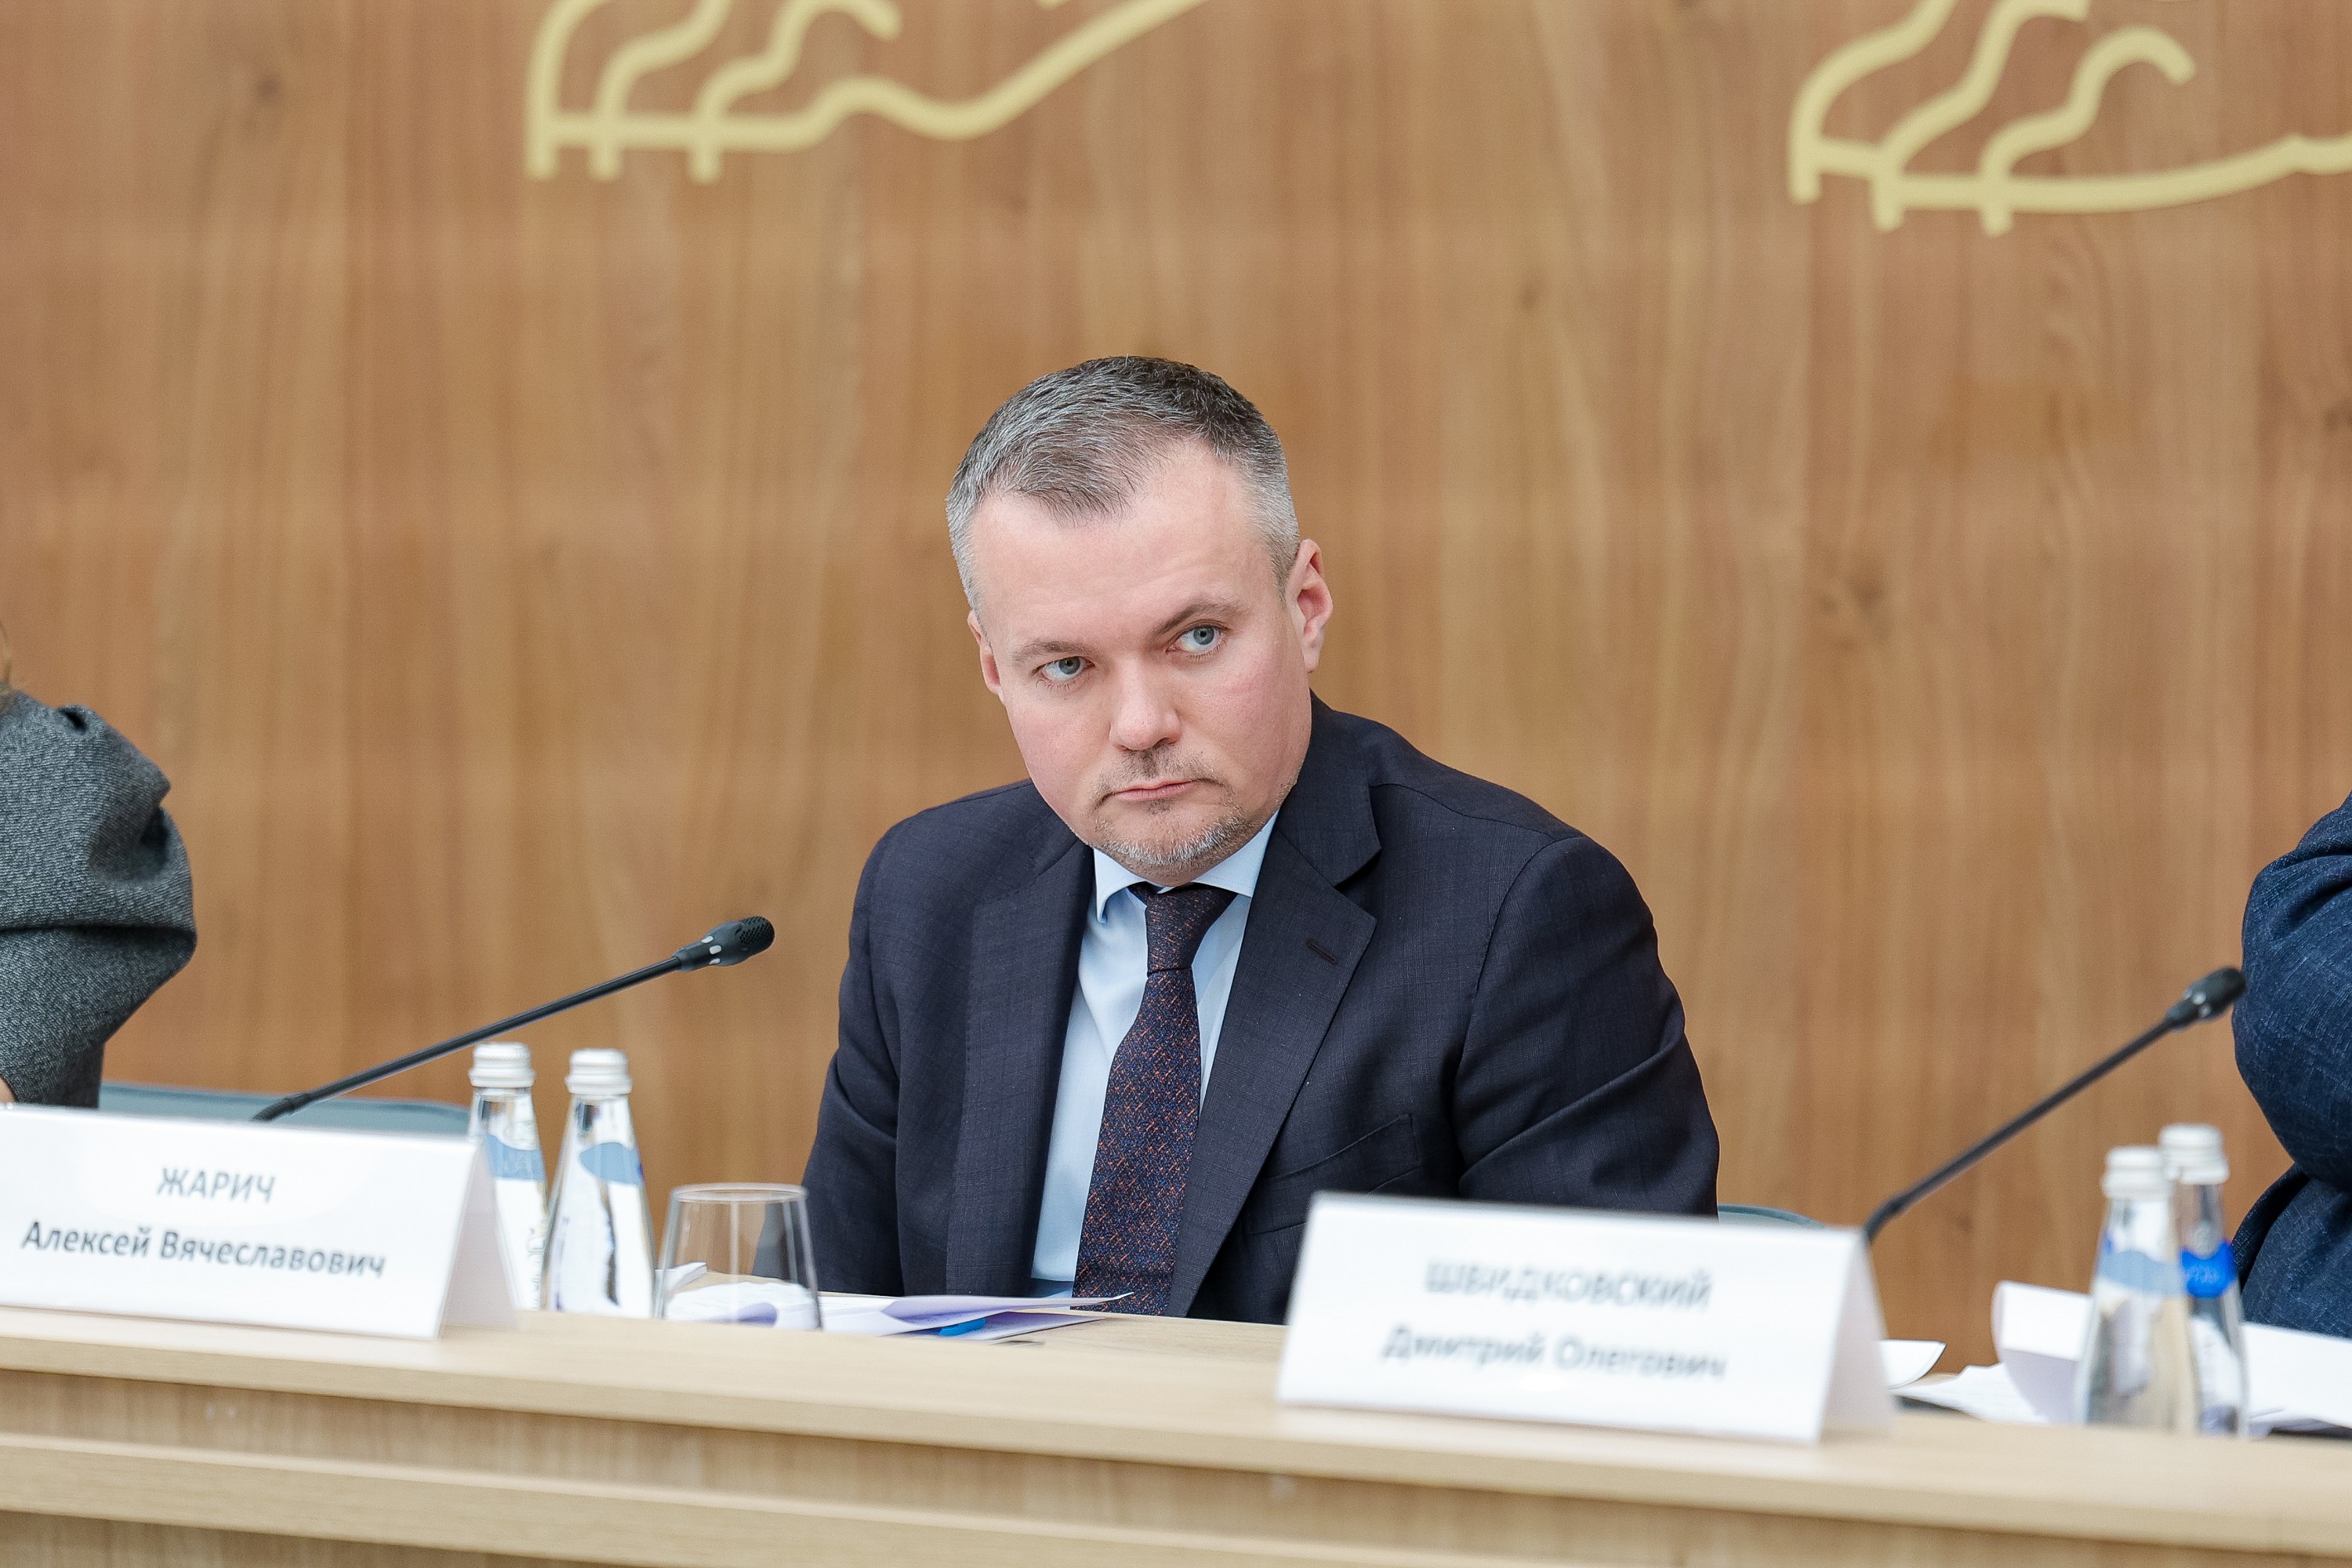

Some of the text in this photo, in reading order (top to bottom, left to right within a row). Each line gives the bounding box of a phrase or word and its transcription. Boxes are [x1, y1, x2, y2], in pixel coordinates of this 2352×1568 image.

[157, 1167, 275, 1202] ЖАРИЧ
[20, 1219, 386, 1277] Алексей Вячеславович
[1425, 1262, 1712, 1308] ШВИДКОВСКИЙ
[1381, 1324, 1727, 1378] Дмитрий Олегович
